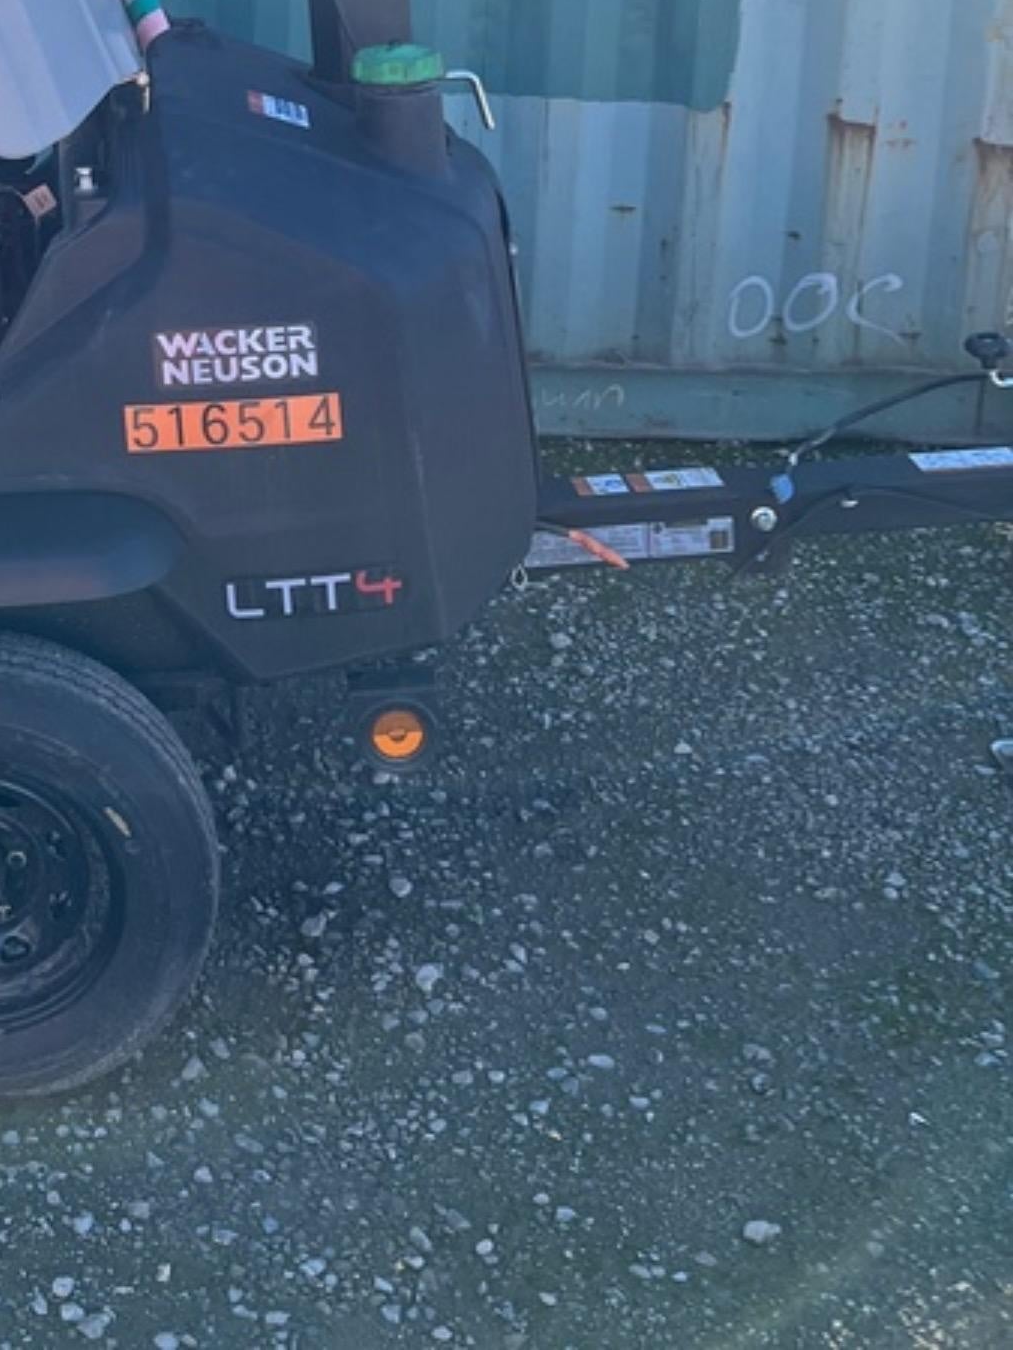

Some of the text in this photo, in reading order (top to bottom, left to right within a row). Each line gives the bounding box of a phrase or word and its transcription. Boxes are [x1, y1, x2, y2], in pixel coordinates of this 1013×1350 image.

[156, 325, 316, 359] WACKER
[162, 350, 319, 386] NEUSON
[132, 395, 336, 448] 516514
[226, 570, 403, 620] LTT4
